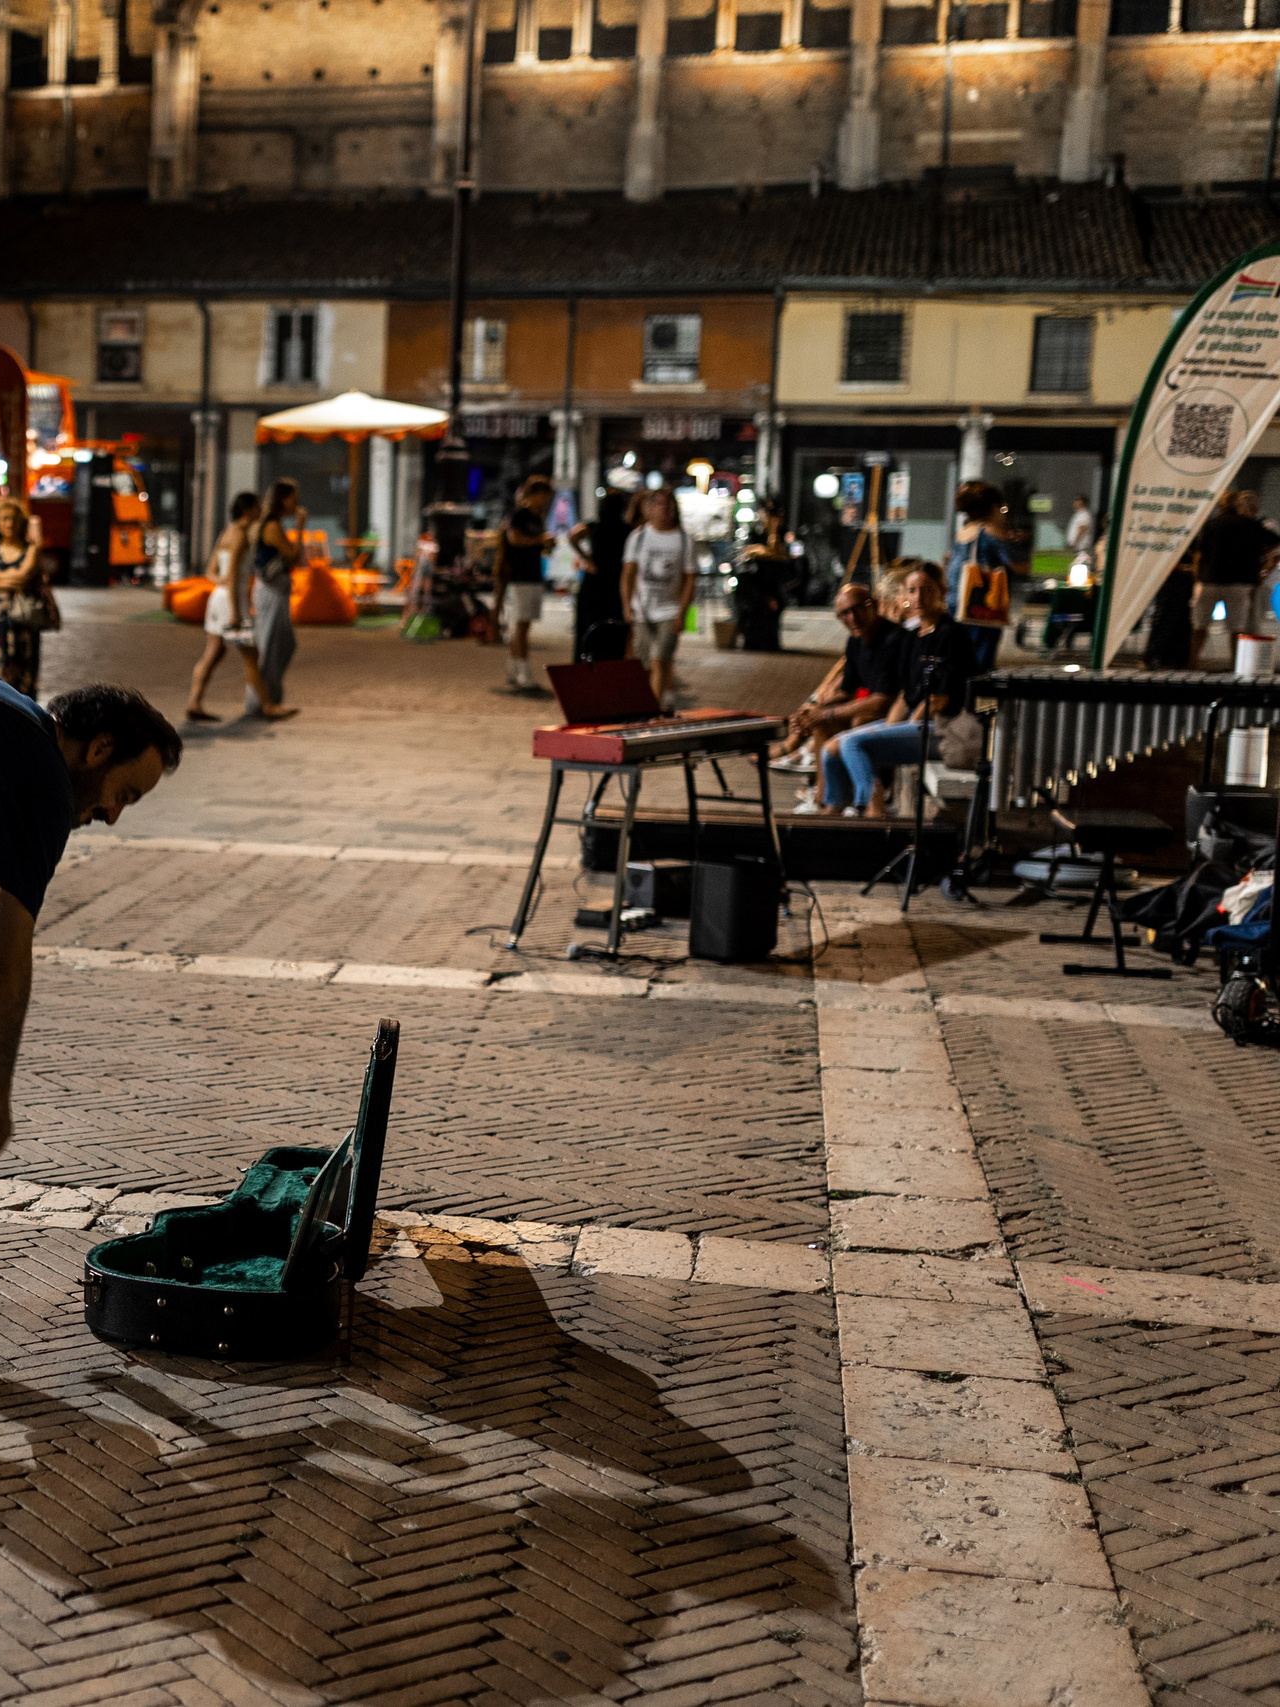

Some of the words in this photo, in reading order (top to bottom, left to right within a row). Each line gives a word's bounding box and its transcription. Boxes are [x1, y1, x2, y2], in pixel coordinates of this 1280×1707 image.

[1217, 311, 1255, 322] sapevi
[1256, 311, 1279, 322] che
[691, 413, 722, 440] OUT
[1133, 484, 1147, 495] La
